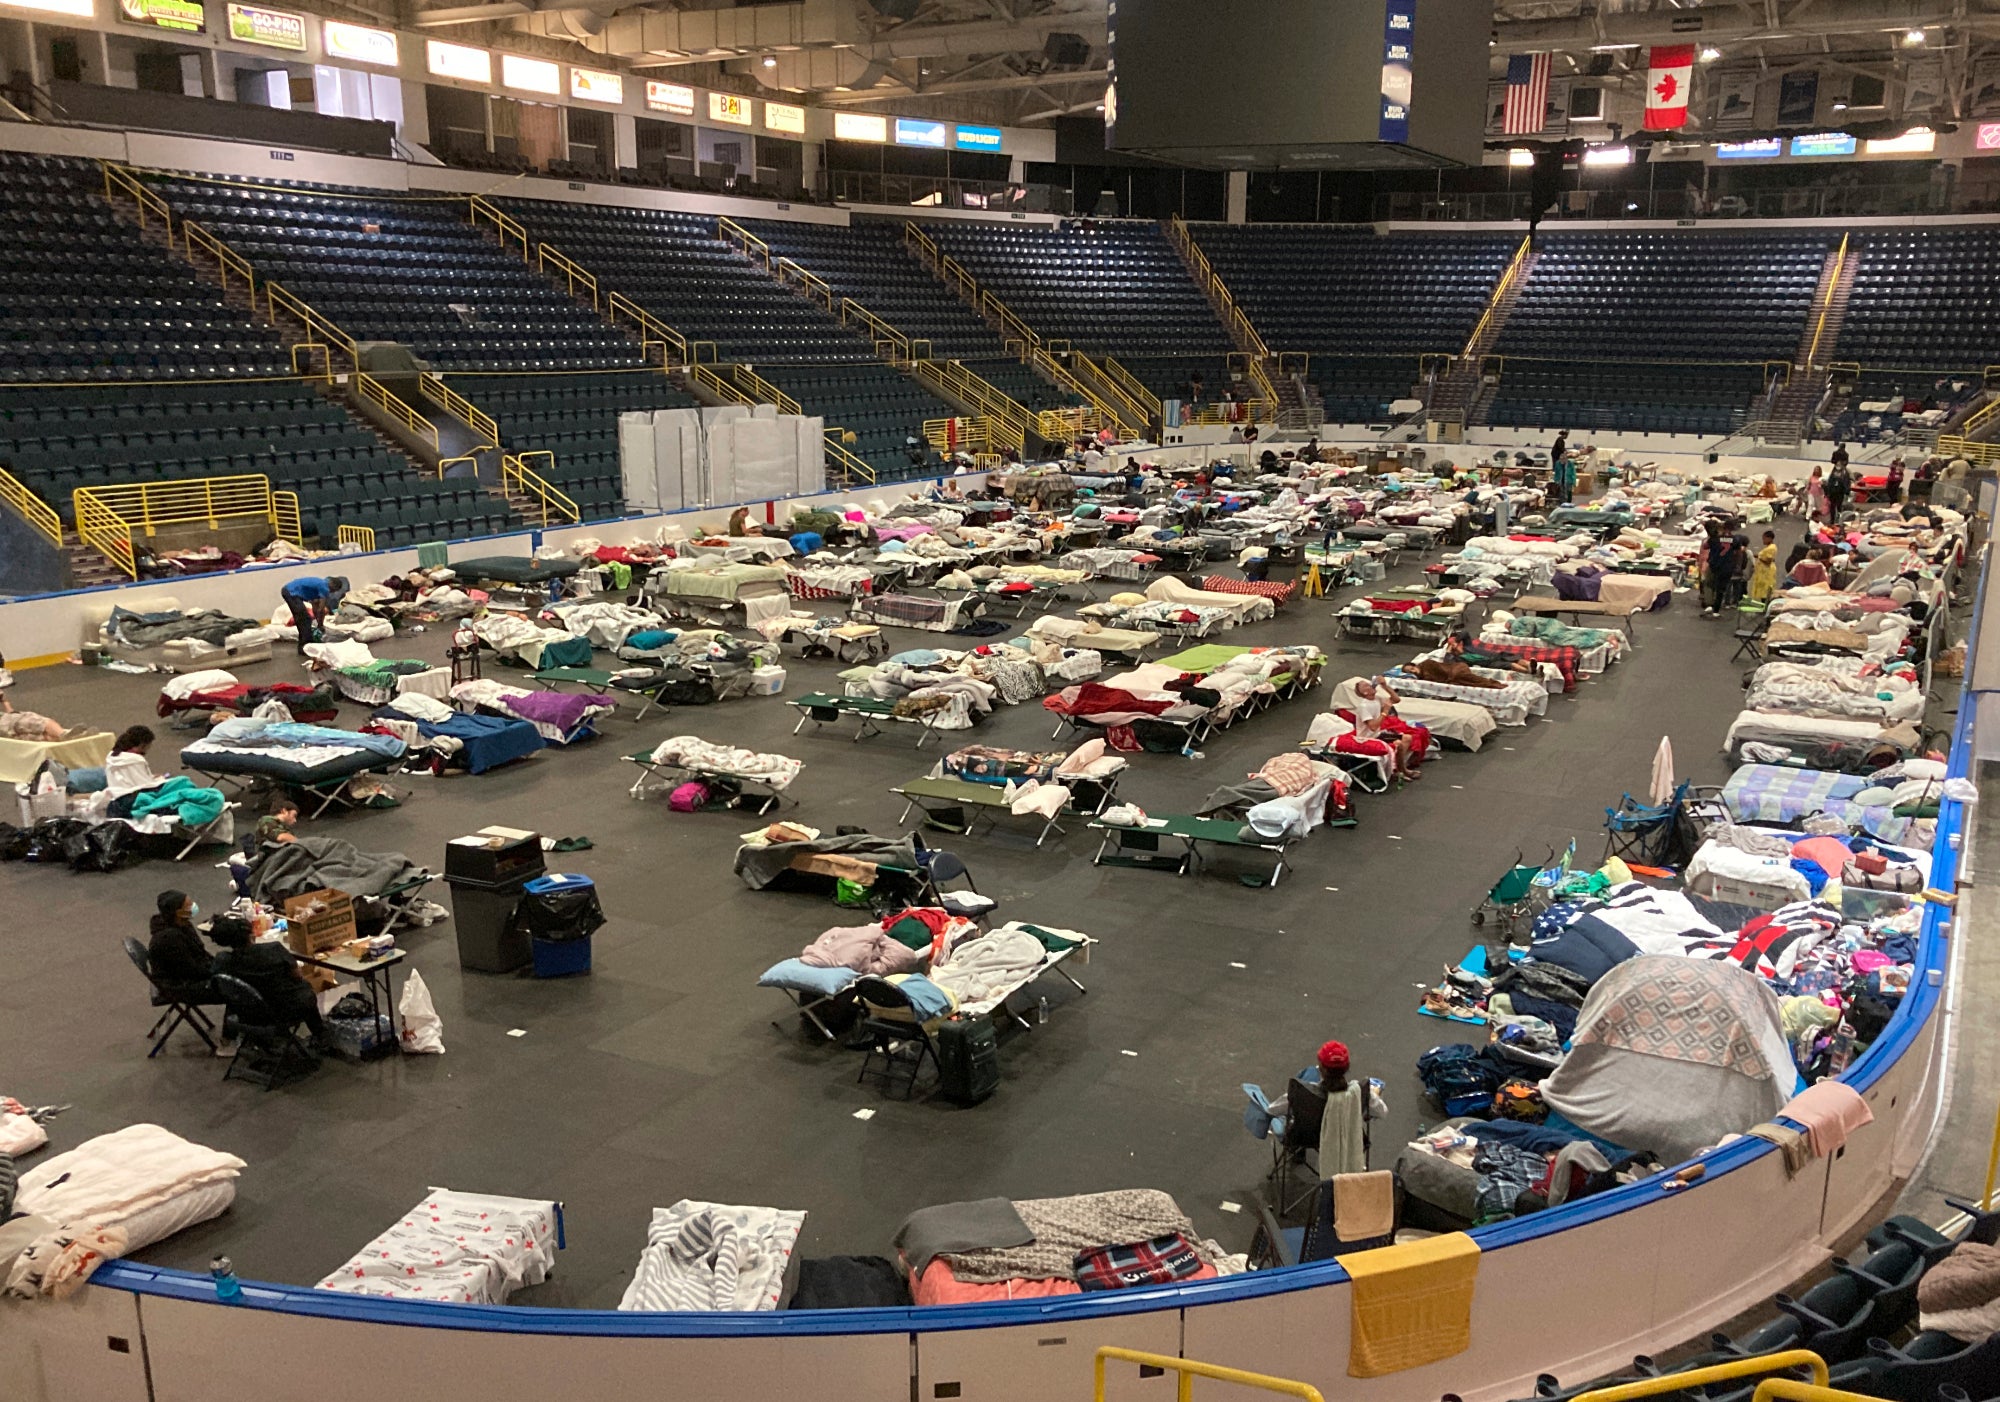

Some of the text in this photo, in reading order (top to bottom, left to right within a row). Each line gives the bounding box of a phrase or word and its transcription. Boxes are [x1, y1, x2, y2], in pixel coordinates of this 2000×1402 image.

[252, 12, 300, 32] GO-PRO
[1390, 21, 1410, 29] LIGHT
[1391, 45, 1407, 53] BUD
[1388, 51, 1409, 59] LIGHT
[1384, 111, 1406, 119] LIGHT
[958, 132, 1000, 145] BUD LIGHT
